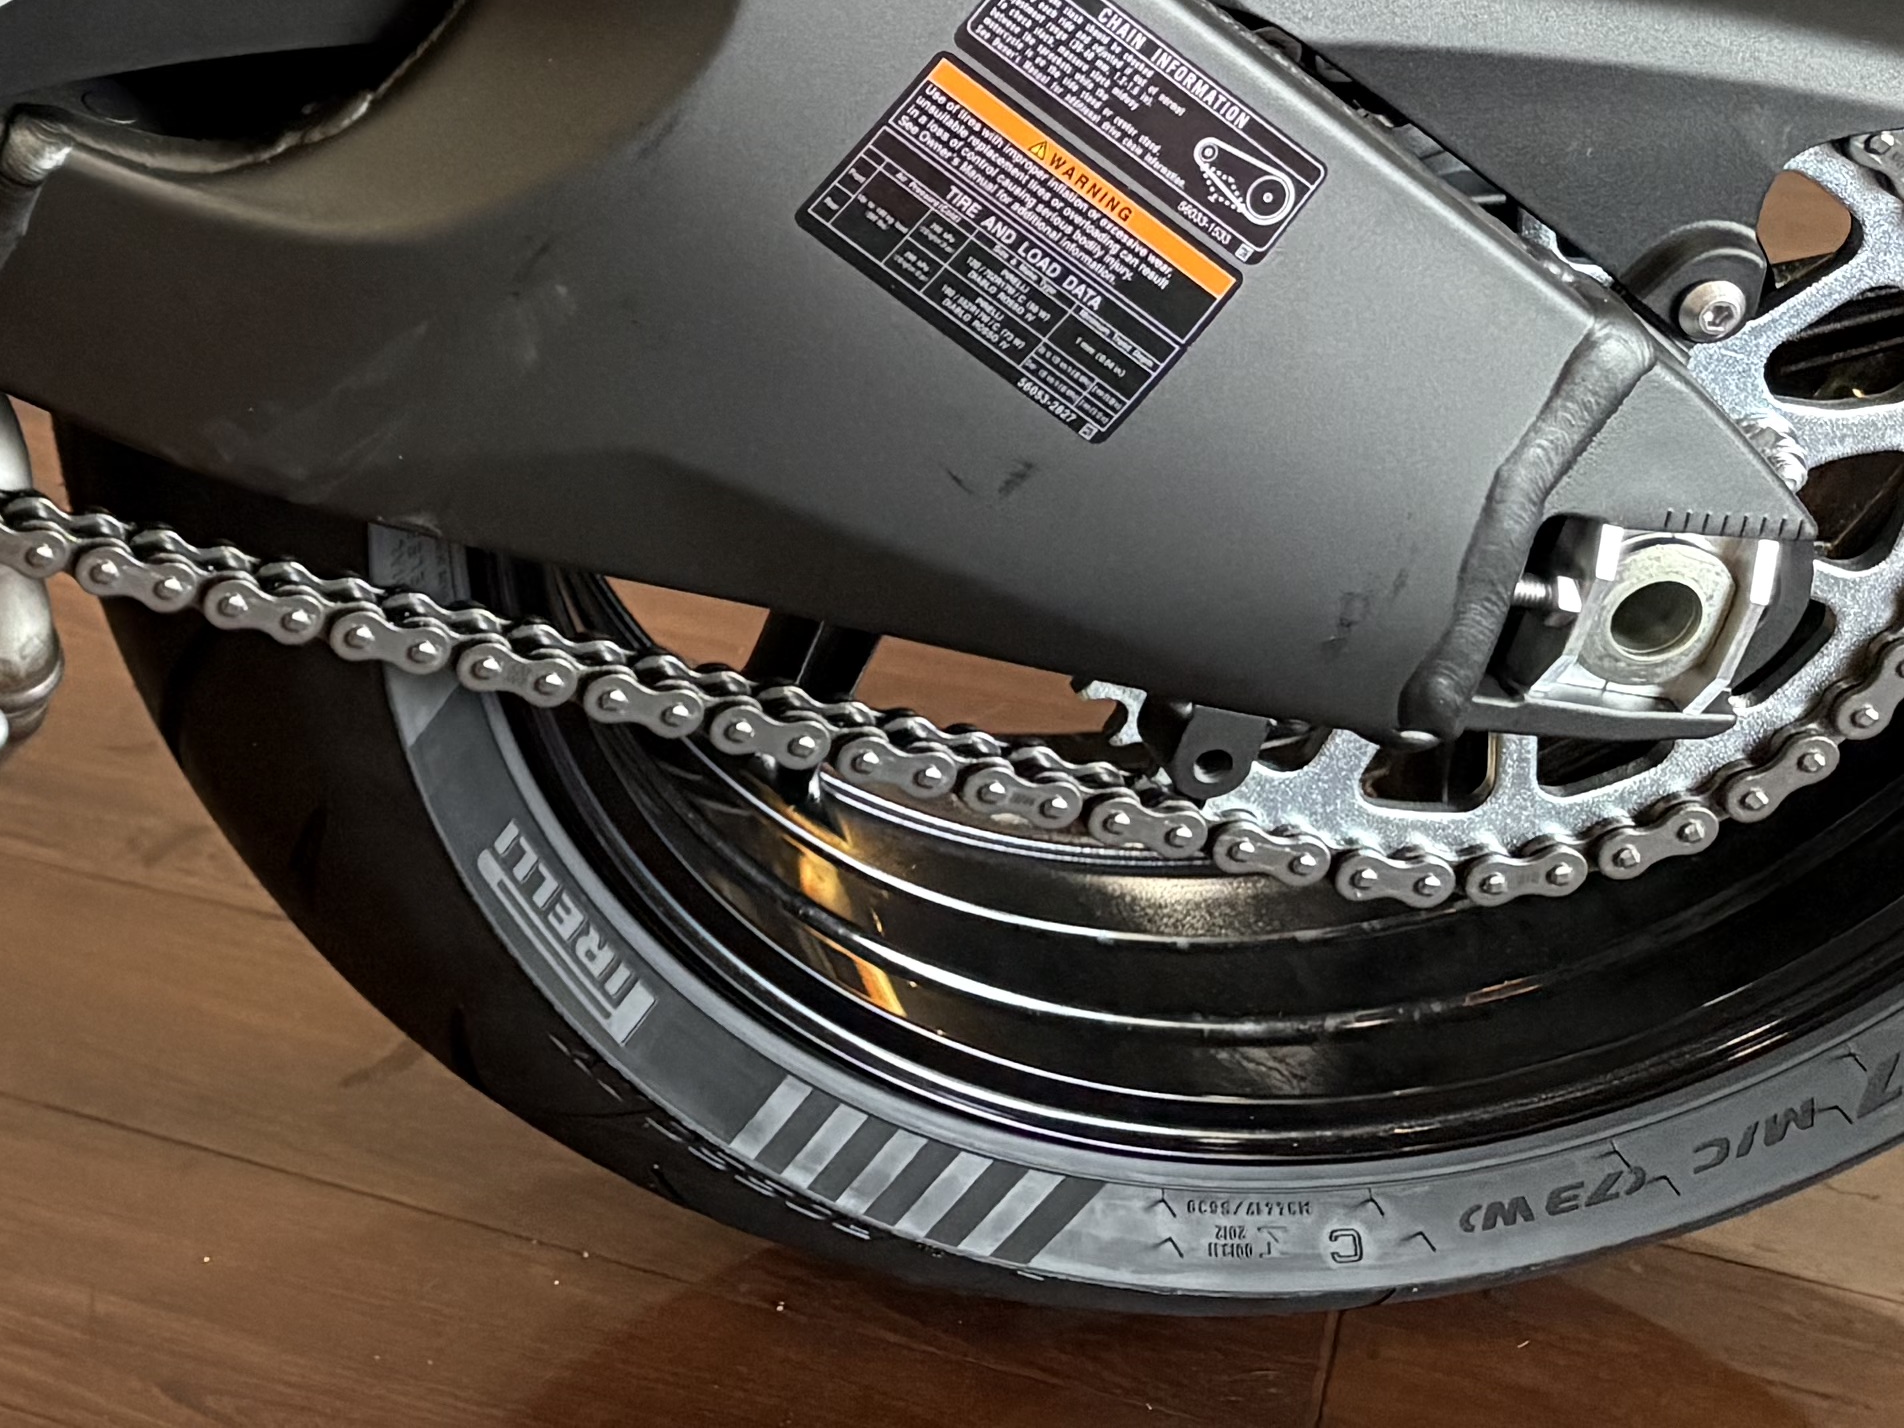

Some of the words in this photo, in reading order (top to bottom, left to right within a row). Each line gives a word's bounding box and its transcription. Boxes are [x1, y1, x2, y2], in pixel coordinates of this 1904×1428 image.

[1094, 5, 1148, 51] CHAIN
[1148, 46, 1252, 129] INFORMATION
[896, 113, 921, 136] See
[916, 129, 963, 167] Owner's
[958, 160, 998, 194] Manual
[994, 187, 1014, 206] for
[1009, 199, 1062, 242] additional
[905, 103, 921, 118] in
[917, 112, 930, 125] a
[925, 118, 952, 142] loss
[947, 135, 964, 151] of
[959, 144, 1000, 178] control
[993, 171, 1038, 208] causing
[1034, 200, 1075, 235] serious
[1069, 228, 1106, 260] bodily
[914, 93, 971, 139] unsuitable
[965, 132, 1030, 185] replacement
[1026, 178, 1053, 201] tires
[1048, 195, 1065, 210] or
[1059, 204, 1122, 255] overloading
[1117, 247, 1141, 268] can
[1136, 261, 1170, 290] result
[923, 83, 948, 105] Use
[944, 99, 961, 115] of
[955, 108, 984, 132] tires
[979, 125, 1005, 149] with
[1000, 142, 1050, 184] improper
[1045, 176, 1090, 213] inflation
[1085, 206, 1102, 222] or
[1097, 215, 1150, 258] excessive
[1046, 152, 1134, 222] WARNING
[941, 184, 983, 219] TIRE
[979, 212, 1019, 246] AND
[1016, 240, 1064, 280] LOAD
[1060, 274, 1105, 311] DATA
[966, 269, 998, 295] DIABLO
[995, 291, 1025, 316] ROSSO
[1023, 312, 1036, 323] IV
[941, 297, 972, 323] DIABLO
[970, 319, 1000, 344] ROSSO
[997, 339, 1010, 351] IV
[477, 819, 656, 1046] PIRELLI
[1545, 1166, 1647, 1218] (73
[1692, 1097, 1815, 1175] M/C
[1458, 1195, 1536, 1235] W)
